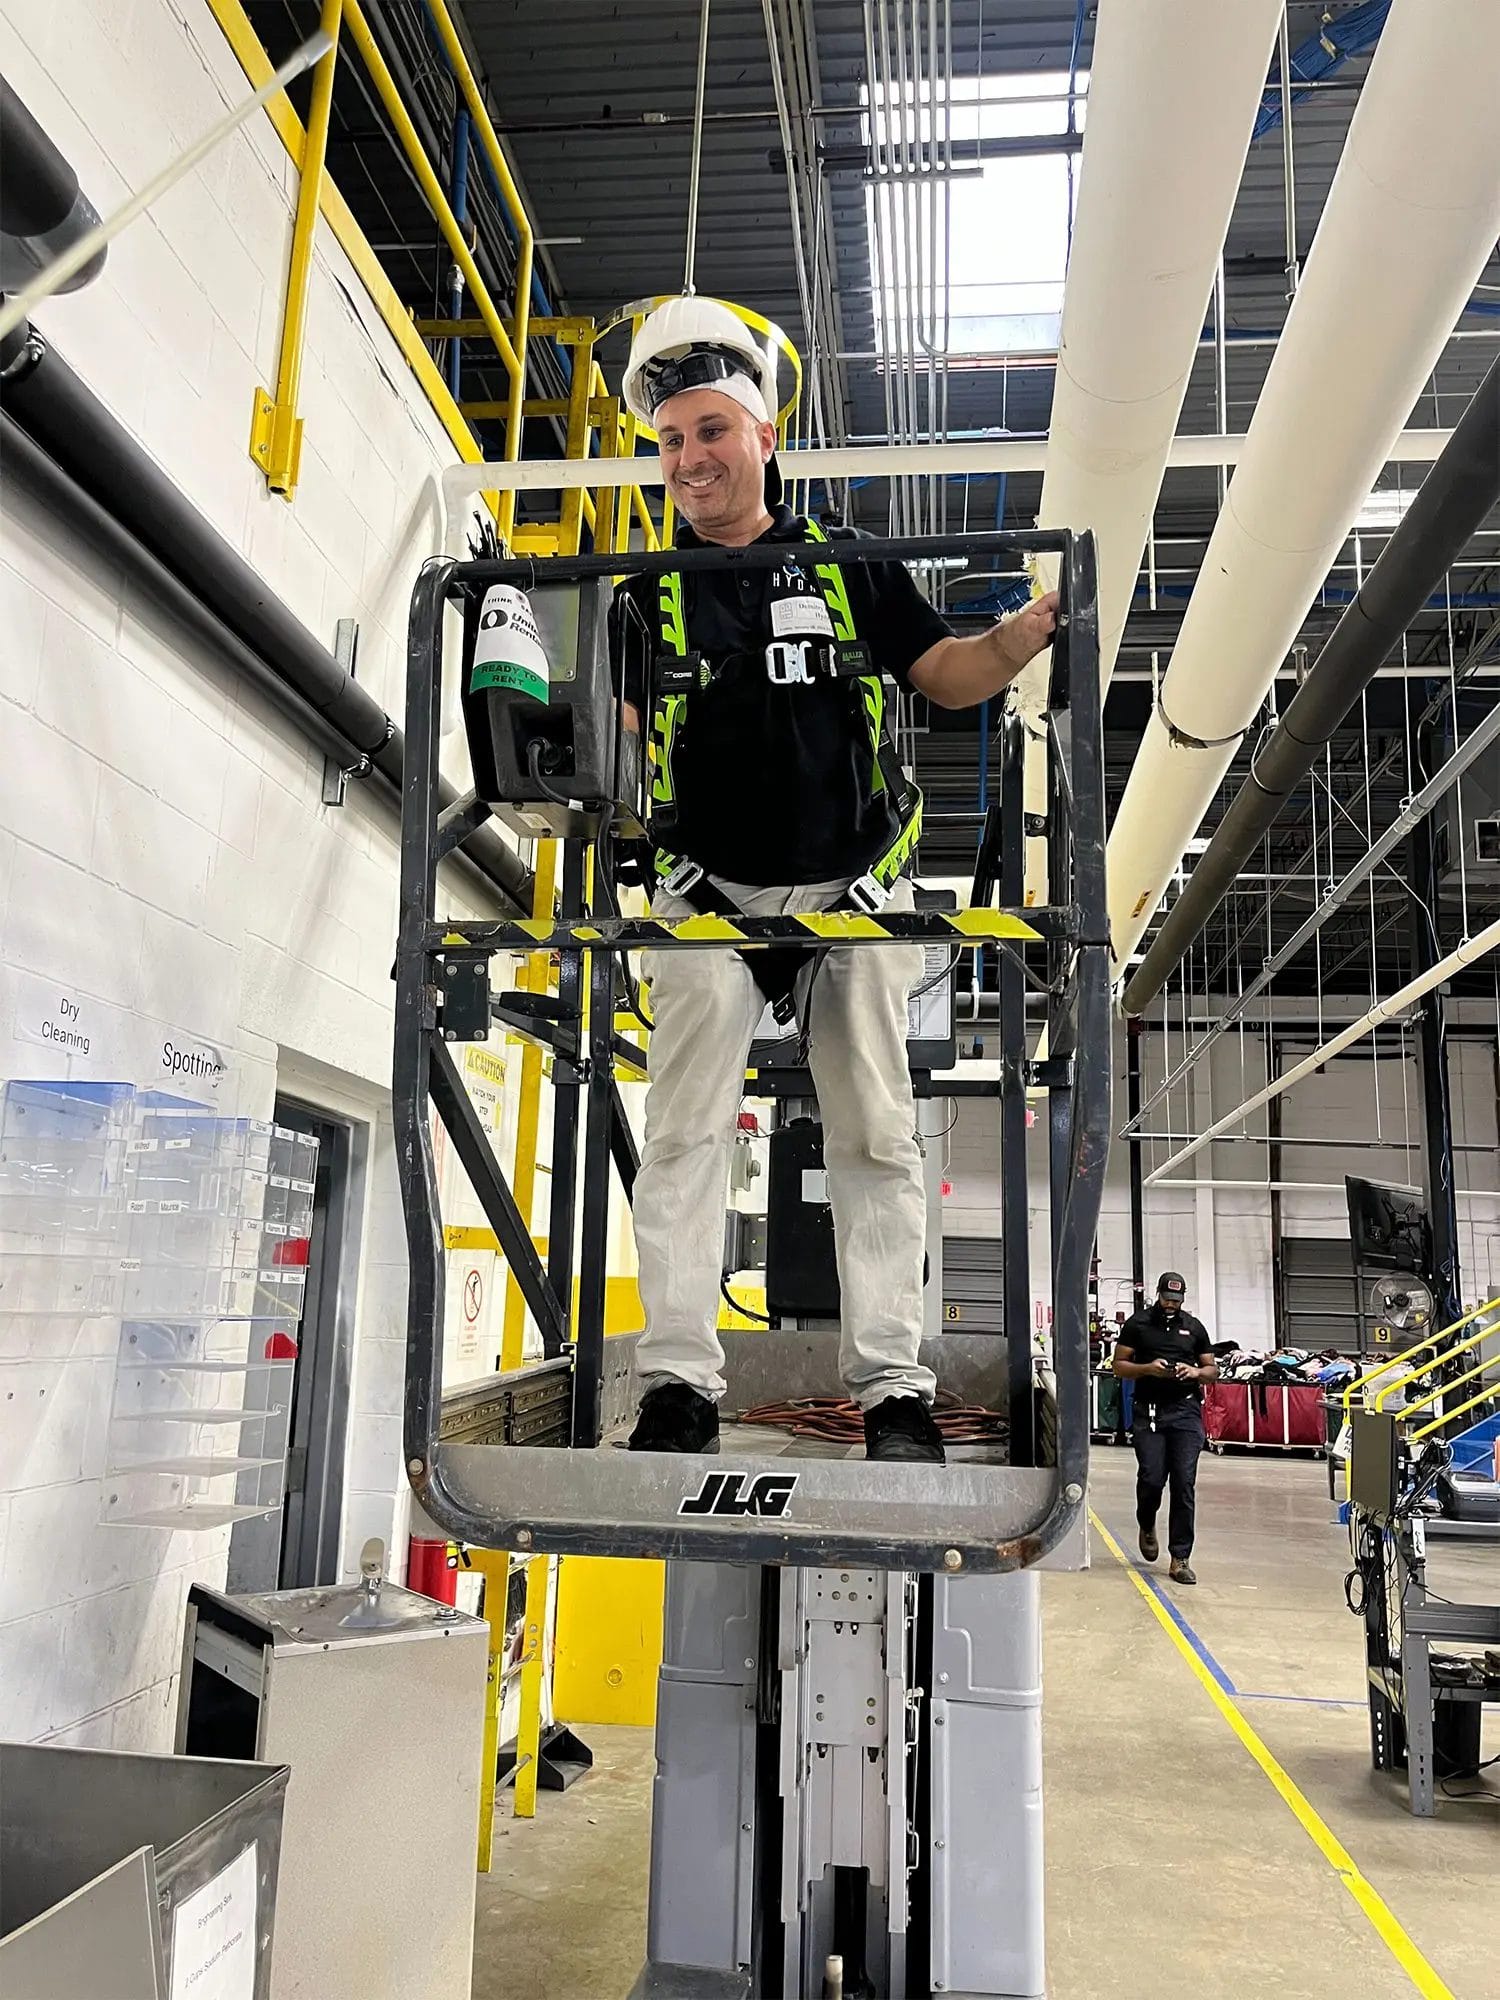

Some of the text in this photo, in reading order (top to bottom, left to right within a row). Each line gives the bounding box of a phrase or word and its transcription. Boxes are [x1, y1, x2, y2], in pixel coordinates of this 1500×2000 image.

[487, 597, 513, 605] THINK
[481, 665, 537, 682] READY TO
[492, 674, 523, 687] RENT
[60, 998, 80, 1022] Dry
[41, 1021, 91, 1055] Cleaning
[162, 1042, 222, 1088] Spotting
[475, 1054, 506, 1083] CAUTION
[948, 1306, 958, 1319] 8
[1379, 1328, 1388, 1341] 9
[677, 1471, 800, 1518] JLG
